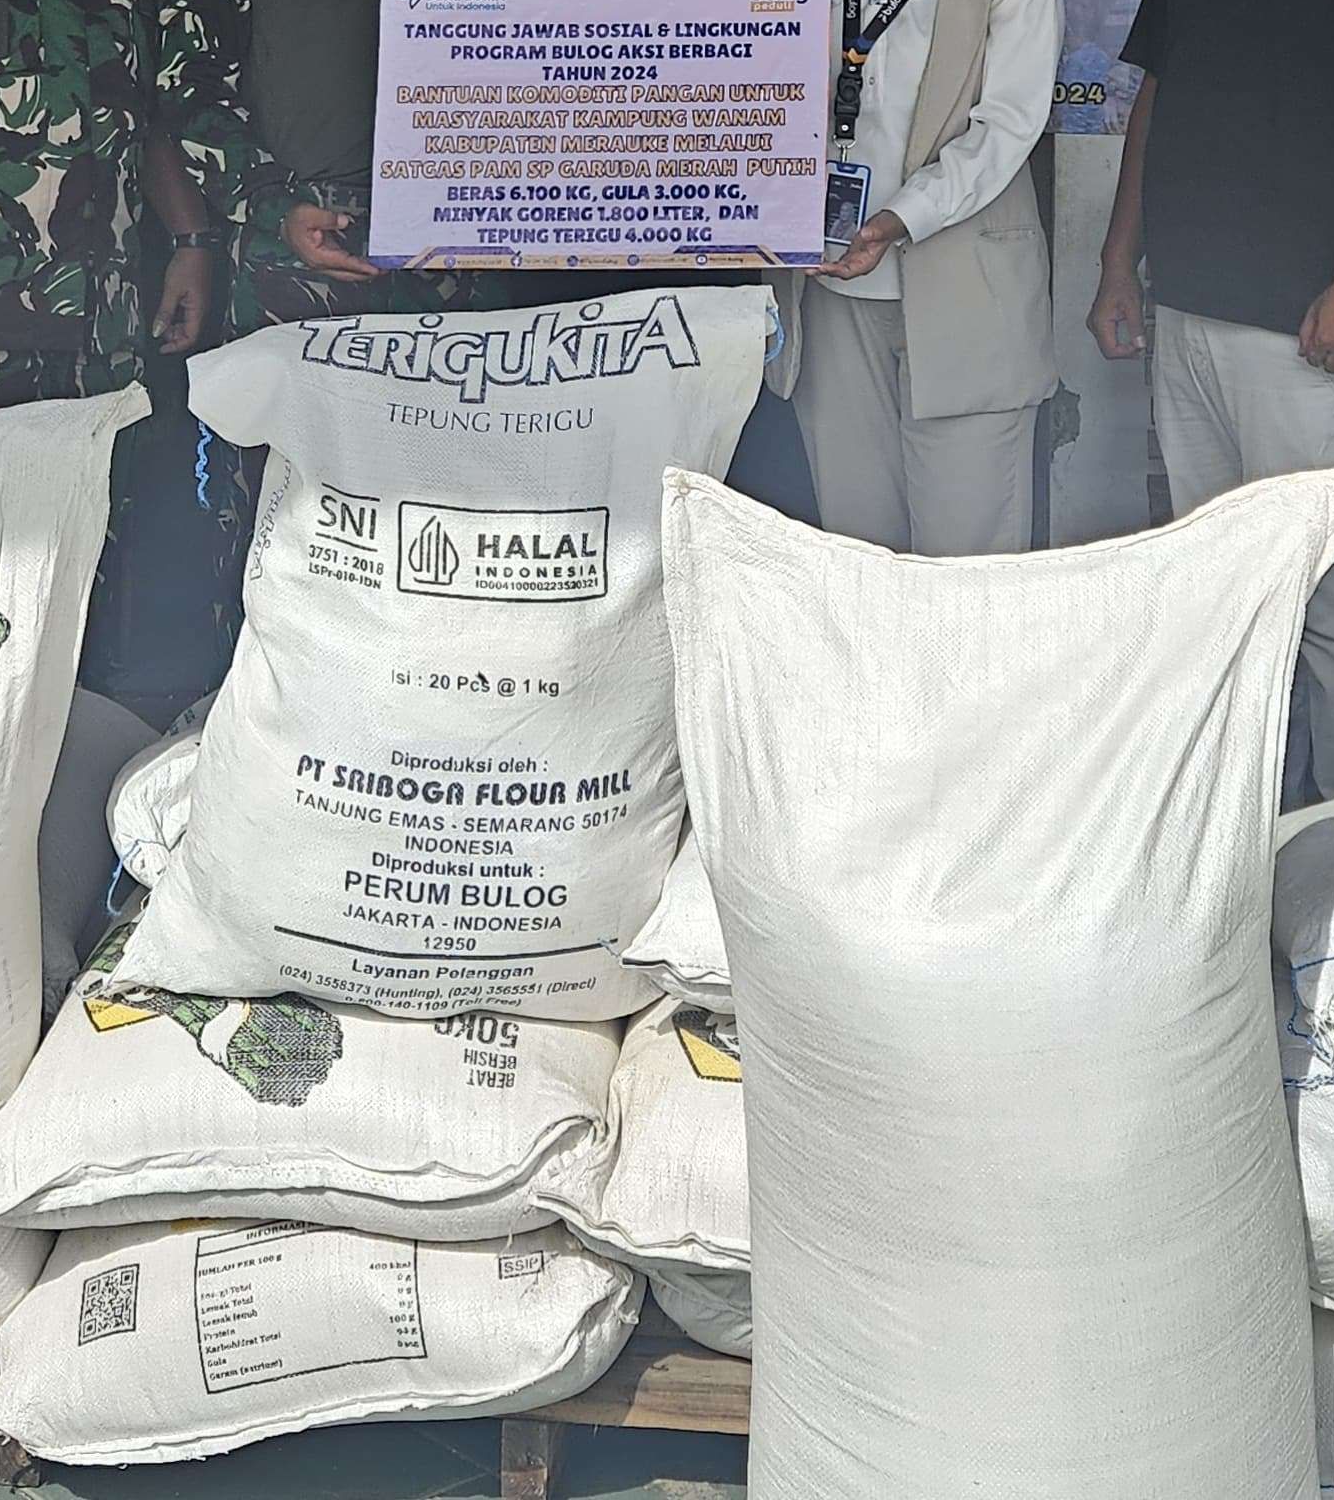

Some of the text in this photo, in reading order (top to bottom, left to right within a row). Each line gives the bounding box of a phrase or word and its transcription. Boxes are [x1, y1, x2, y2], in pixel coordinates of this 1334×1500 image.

[425, 1, 506, 11] Untuk Indonesia
[753, 1, 792, 11] peduli
[404, 22, 801, 38] TANGGUNG JAWAB SOSIAL & LINGKUNGAN
[451, 43, 753, 60] PROGRAM BULOG AKSI BERBAGI
[542, 65, 658, 80] TAHUN 2024
[397, 83, 805, 104] BANTUAN KOMODITI PANGAN UNTUK
[413, 108, 786, 129] MASYARAKAT KAMPUNG WANAM
[425, 133, 773, 154] KABUPATEN MERAUKE MELALUI
[380, 158, 816, 179] SATGAS PAM SP GARUDA MERAH PUTIH
[447, 184, 747, 203] BERAS 6.100 KG, GULA 3.000 KG,
[433, 205, 759, 222] MINYAK GORENG 1.800 LITER, DAN
[477, 227, 712, 244] TEPUNG TERIGU 4.000 KG
[386, 403, 595, 433] TEPUNG TERIGU
[318, 494, 378, 540] SNI
[477, 533, 598, 560] HALAL
[308, 544, 385, 576] 3751 2018
[308, 561, 382, 590] LSPr-010-IDN
[475, 564, 598, 578] INDONESIA
[391, 669, 561, 698] Isi 20 Pcs @ 1 kg
[391, 750, 538, 774] Diproduksi oleh
[297, 754, 632, 807] PT SRIBOGA FLOUR MILL
[295, 788, 628, 834] TANJUNG EMAS SEMARANG 50174
[405, 835, 515, 856] INDONESIA
[372, 852, 533, 878] Diproduksi untuk
[344, 870, 568, 908] PERUM BULOG
[343, 903, 563, 931] JAKARTA INDONESIA
[424, 936, 477, 951] 12950
[352, 958, 535, 981] Layanan Pelanggan
[279, 964, 313, 984] (024)
[316, 974, 372, 996] 3558373
[448, 985, 485, 999] (024)
[486, 983, 542, 996] 3565551
[546, 976, 597, 997] (Direct)
[464, 1048, 518, 1070] BERSIH
[466, 1069, 516, 1089] BERAT
[504, 1257, 538, 1273] SSIP
